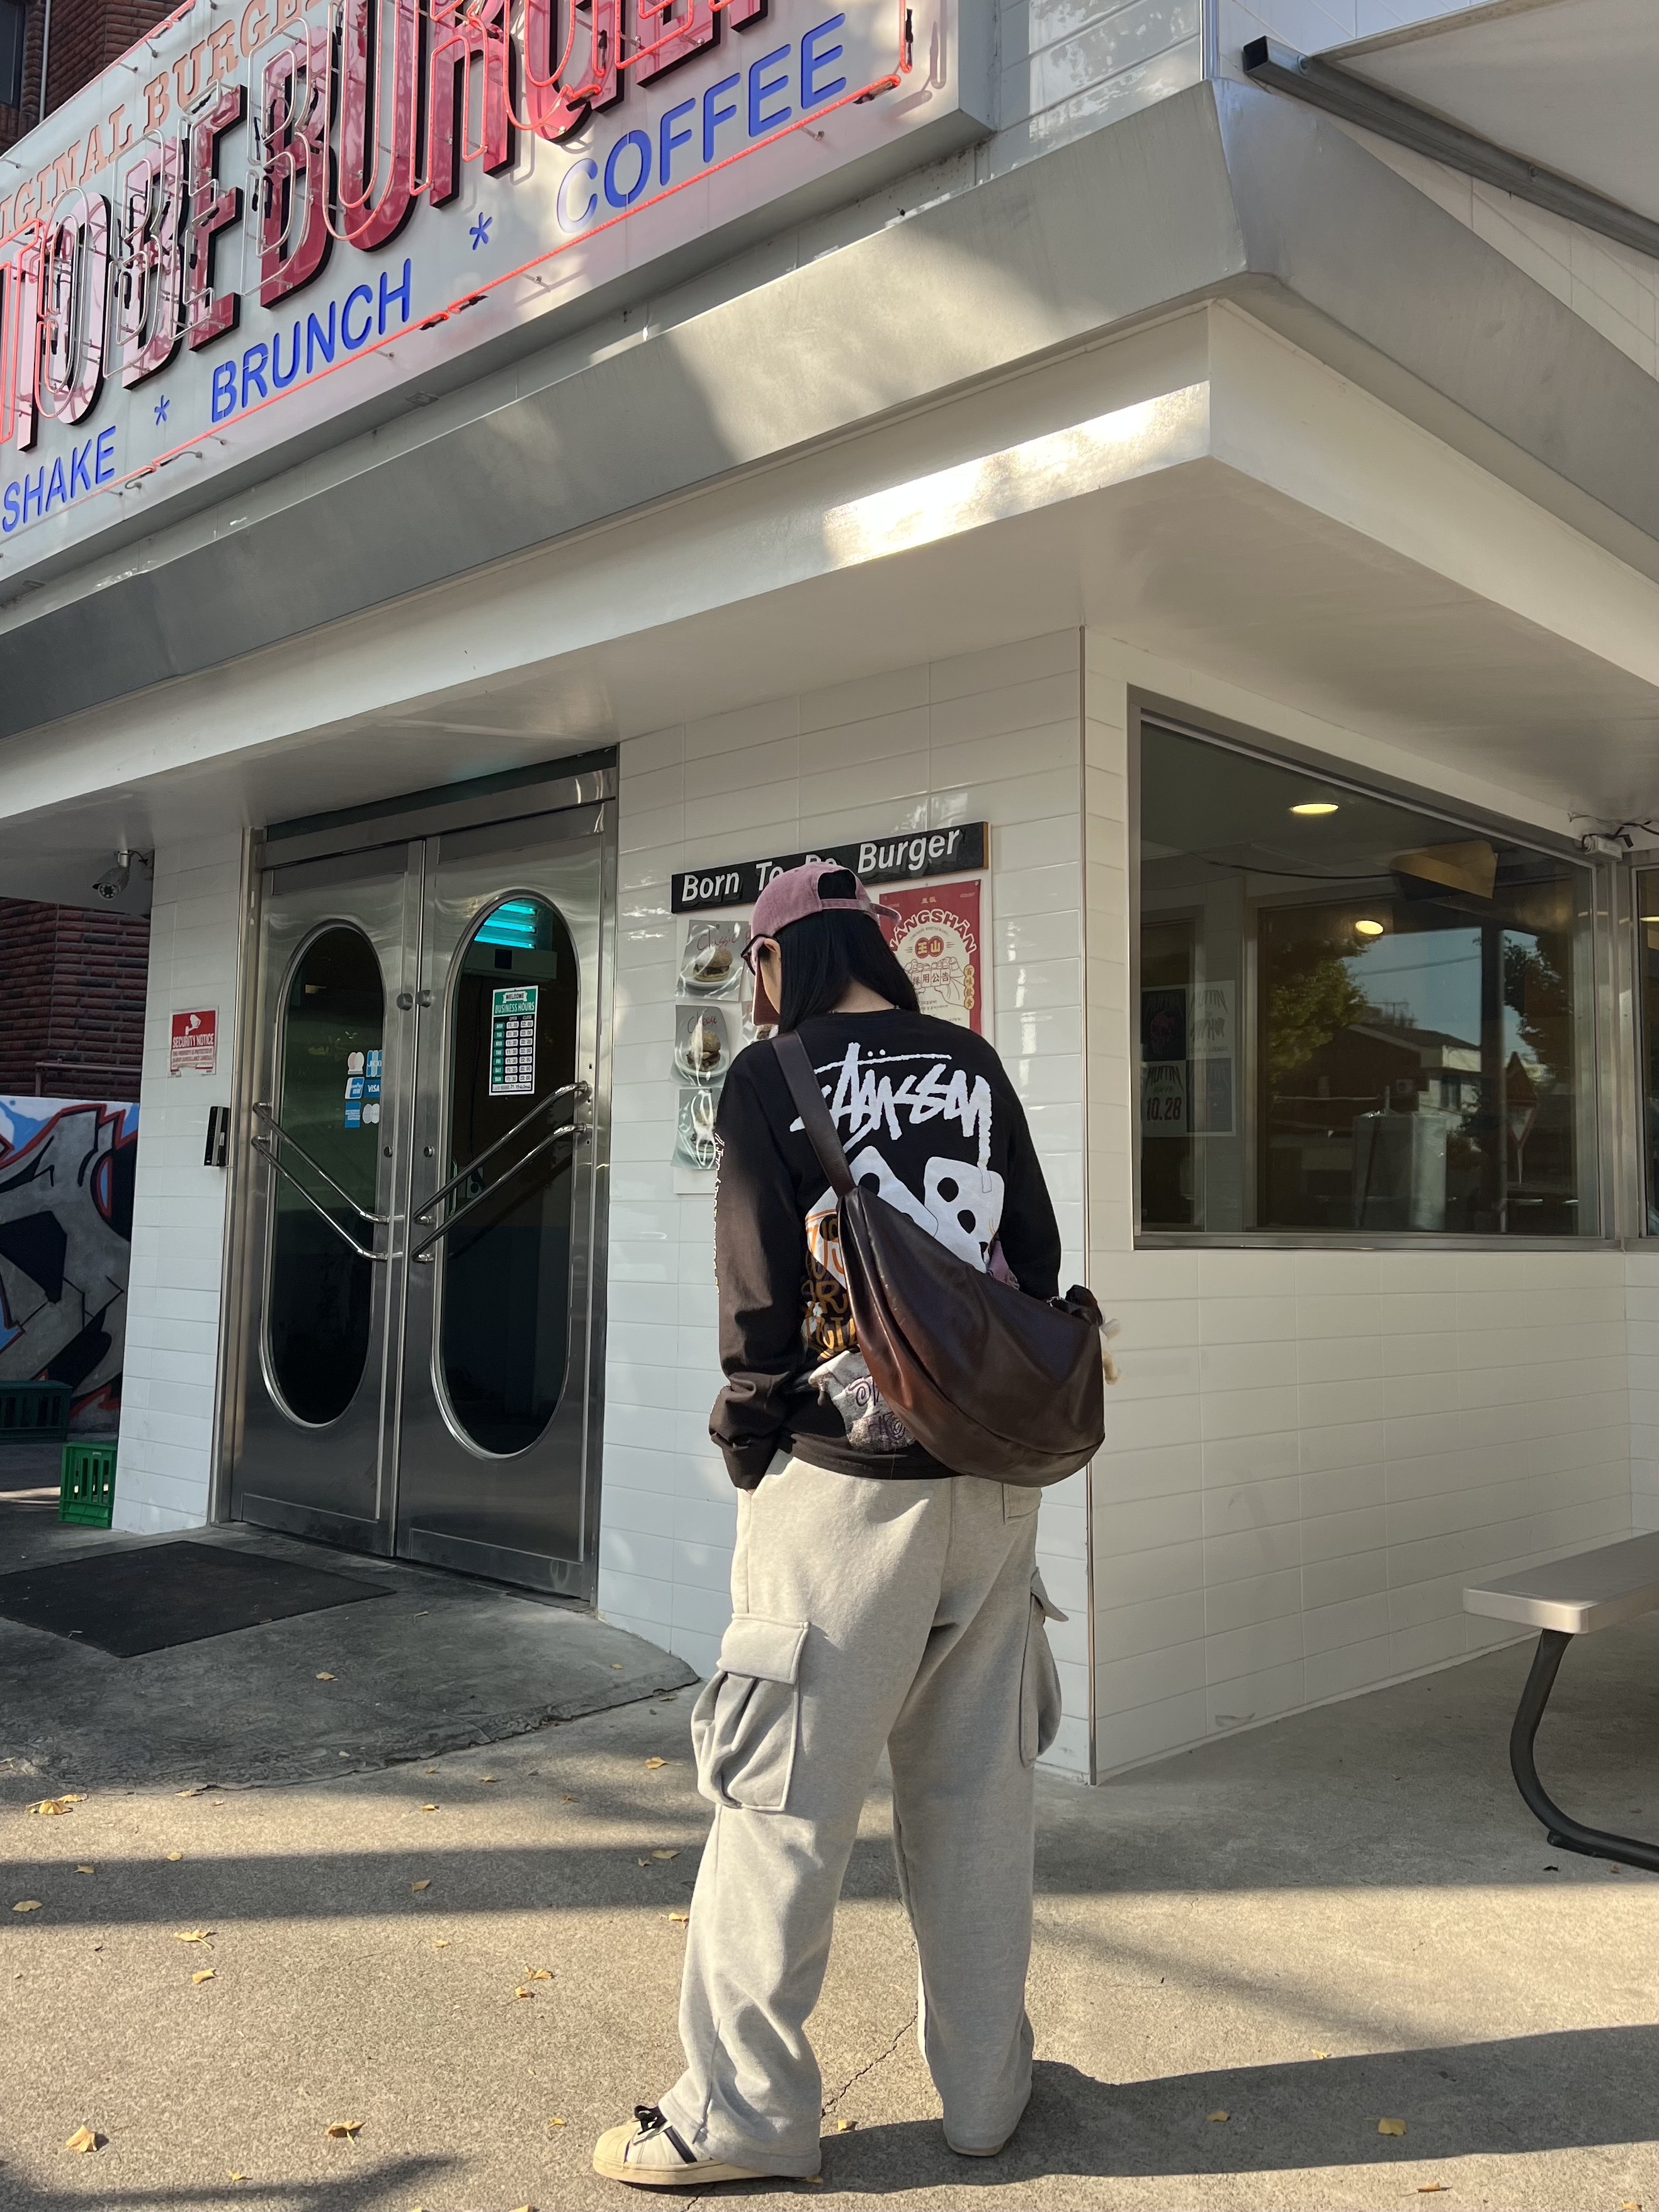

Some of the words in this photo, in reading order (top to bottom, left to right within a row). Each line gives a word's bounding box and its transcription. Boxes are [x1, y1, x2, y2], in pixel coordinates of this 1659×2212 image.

[143, 0, 322, 134] BURG
[2, 426, 116, 533] SHAKE
[212, 259, 411, 423] BRUNCH
[557, 13, 846, 234] COFFEE
[682, 871, 740, 903] Born
[858, 829, 961, 874] Burger
[917, 939, 941, 955] 王山
[495, 1003, 518, 1014] BUSINESS
[518, 1001, 535, 1012] HOURS
[173, 1035, 196, 1048] SECURITY
[196, 1033, 214, 1045] NOTICE
[368, 1084, 380, 1092] VISA
[1146, 1096, 1182, 1121] 10.28
